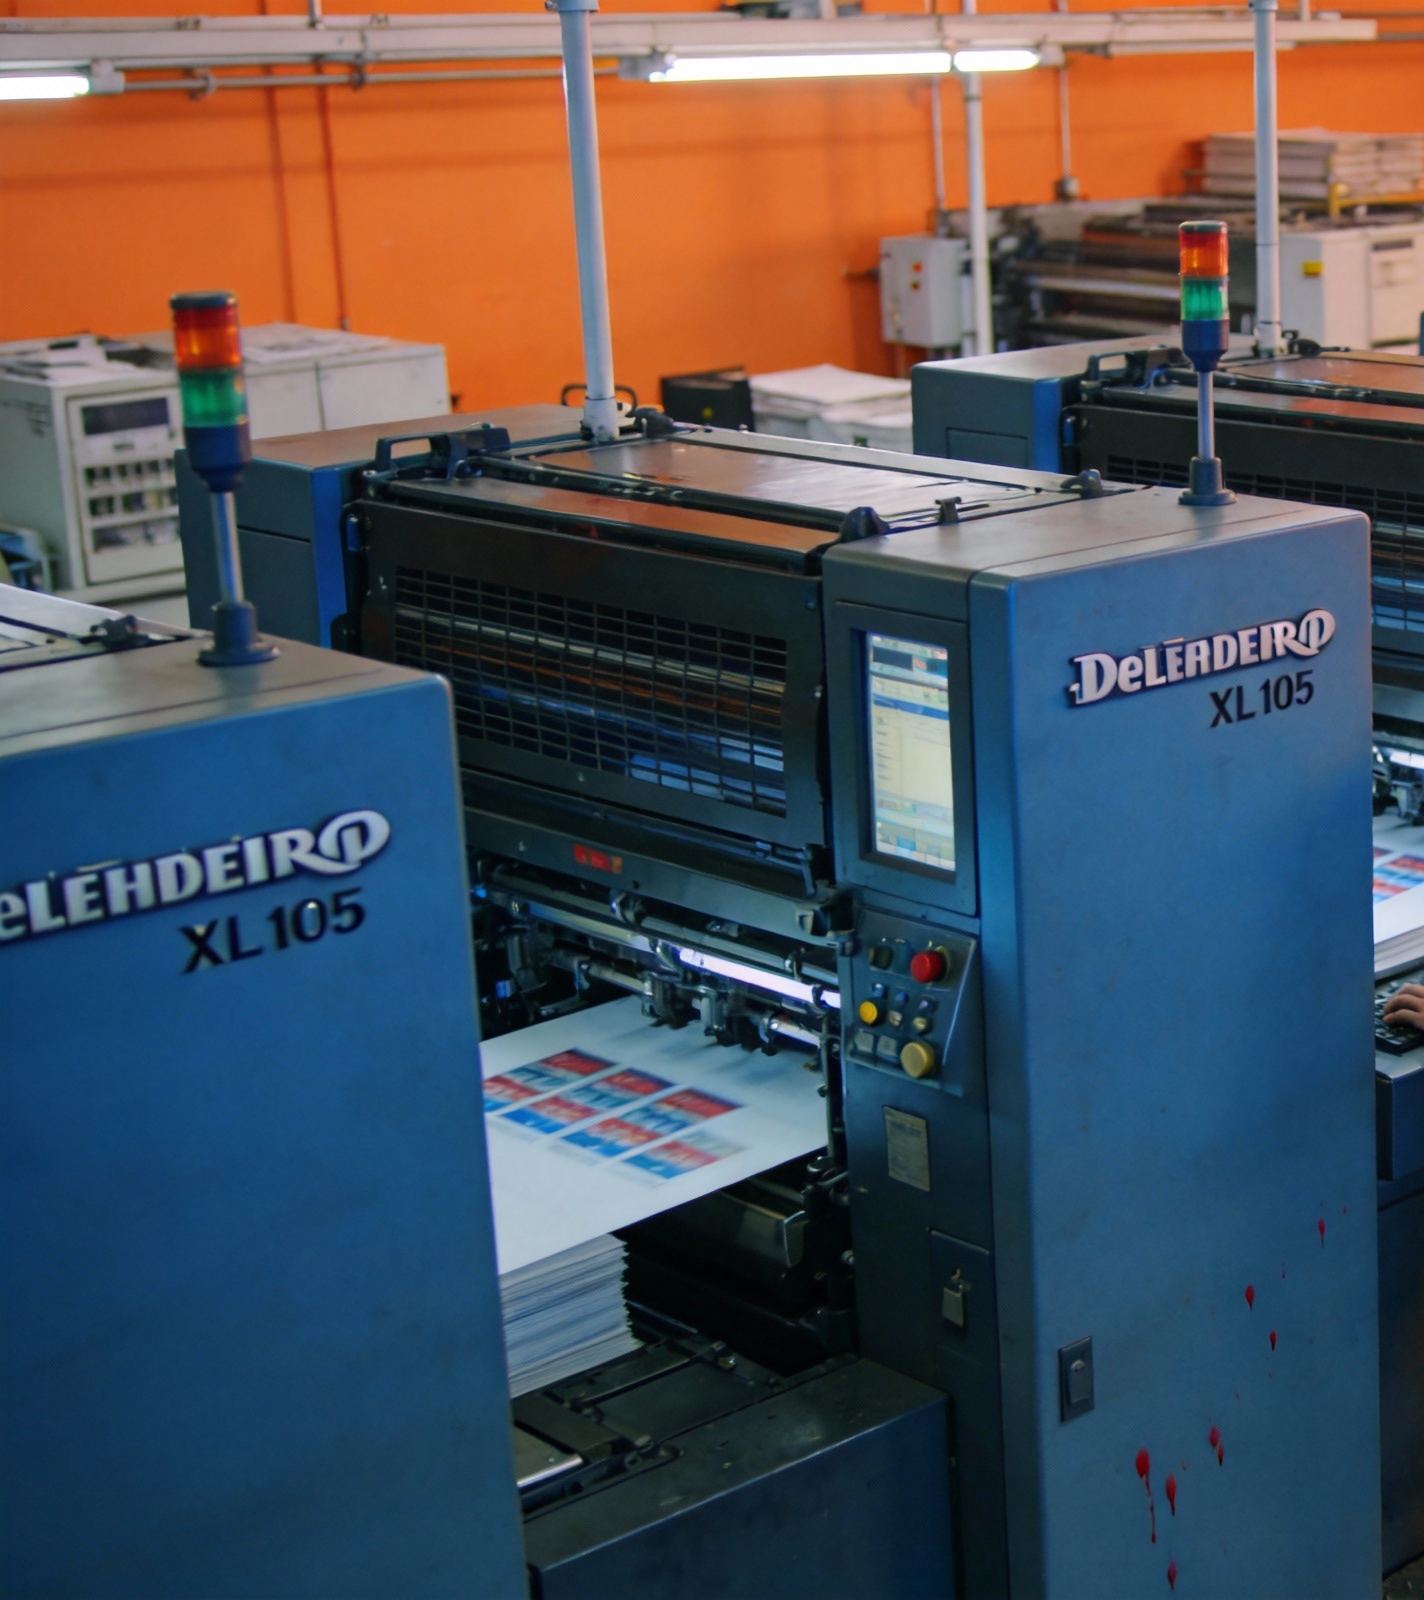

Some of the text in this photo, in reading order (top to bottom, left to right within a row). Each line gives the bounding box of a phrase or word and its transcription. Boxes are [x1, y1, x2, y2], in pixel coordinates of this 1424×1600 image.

[1209, 669, 1314, 728] XL 105
[180, 887, 366, 974] XL 105
